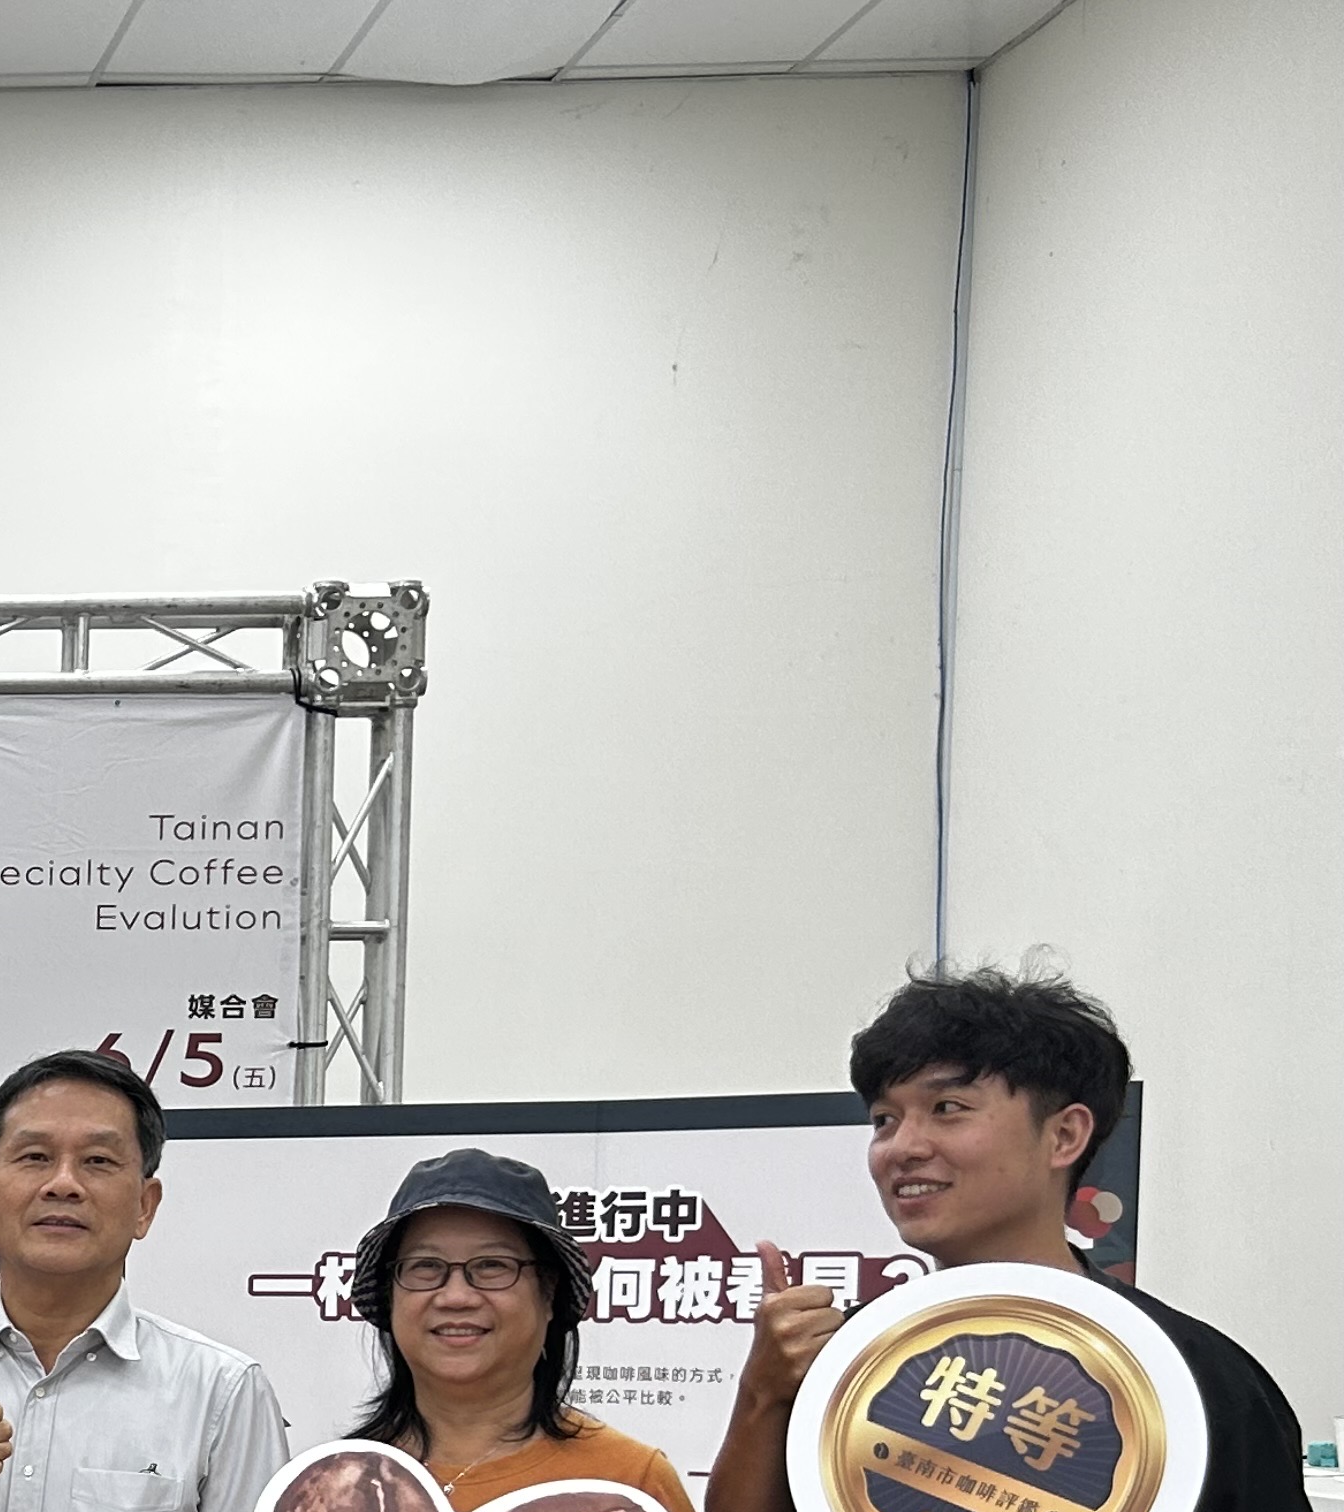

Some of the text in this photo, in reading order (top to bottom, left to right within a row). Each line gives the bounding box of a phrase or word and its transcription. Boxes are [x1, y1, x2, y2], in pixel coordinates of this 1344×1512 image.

[149, 814, 285, 841] Tainan
[150, 858, 284, 886] Coffee
[96, 904, 282, 931] Evalution
[188, 994, 279, 1020] 媒合會
[919, 1355, 1097, 1472] 特等
